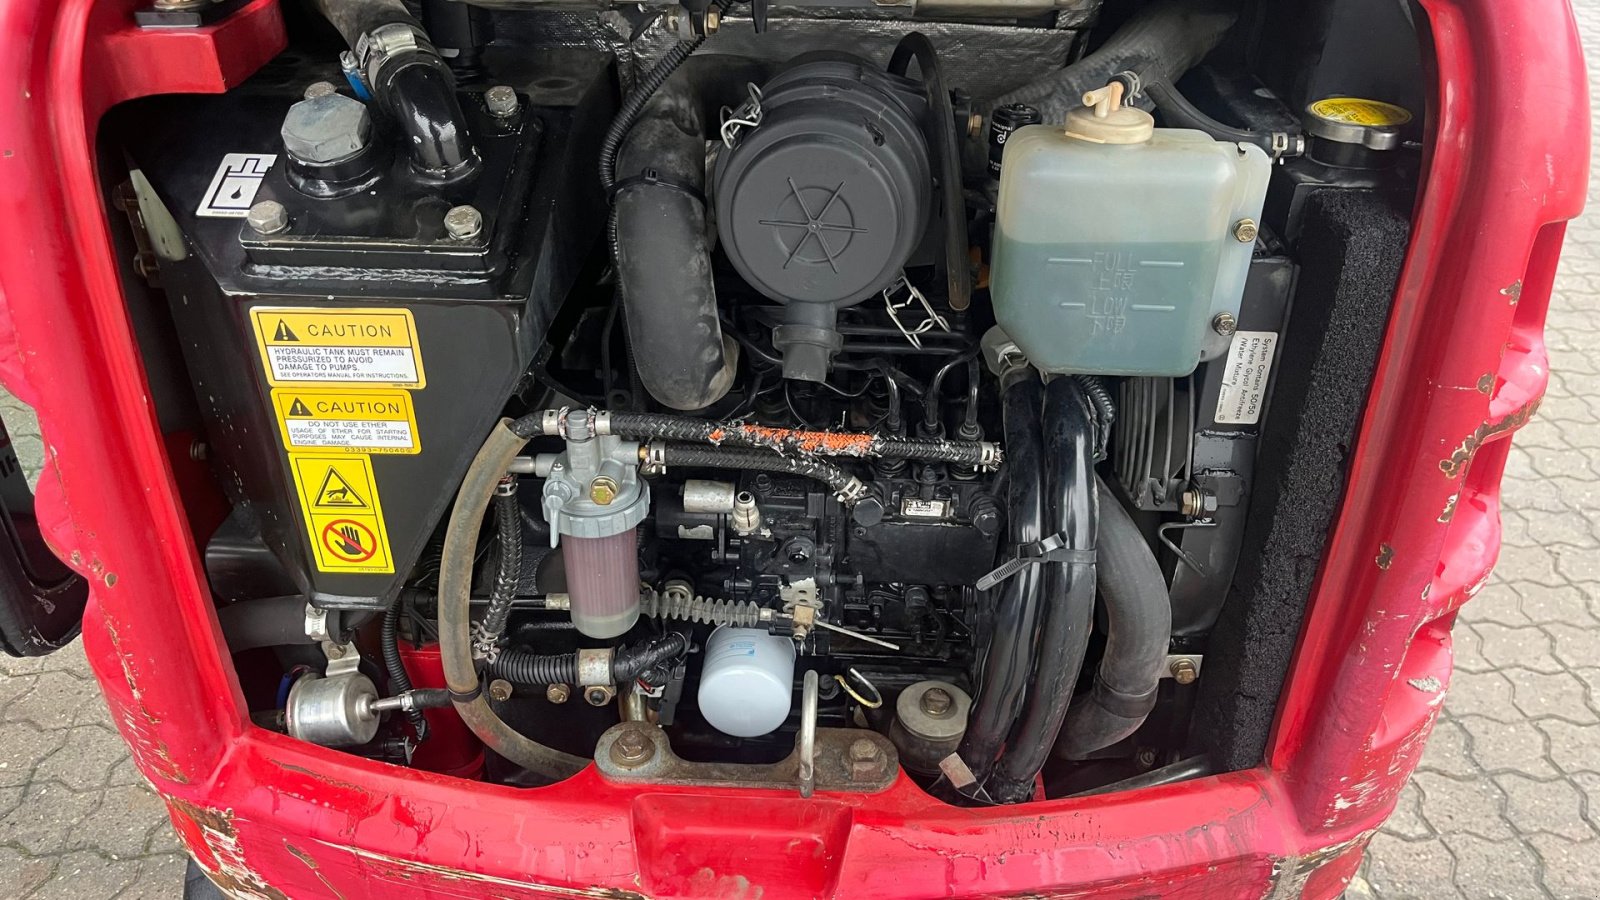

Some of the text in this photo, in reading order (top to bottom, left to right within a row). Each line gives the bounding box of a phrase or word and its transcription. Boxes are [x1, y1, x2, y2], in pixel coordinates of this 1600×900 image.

[1093, 251, 1137, 272] FULL
[1091, 295, 1128, 315] LOW
[307, 324, 392, 337] CAUTION
[274, 348, 321, 356] HYDRAULIC
[323, 348, 346, 356] TANK
[278, 363, 360, 371] DAMAGE TO PUMPS.
[1231, 362, 1243, 386] Mixture
[1247, 338, 1272, 415] System Contains 50/50
[1234, 337, 1260, 420] Ethylene Glycol Antifreeze
[316, 401, 400, 414] CAUTION
